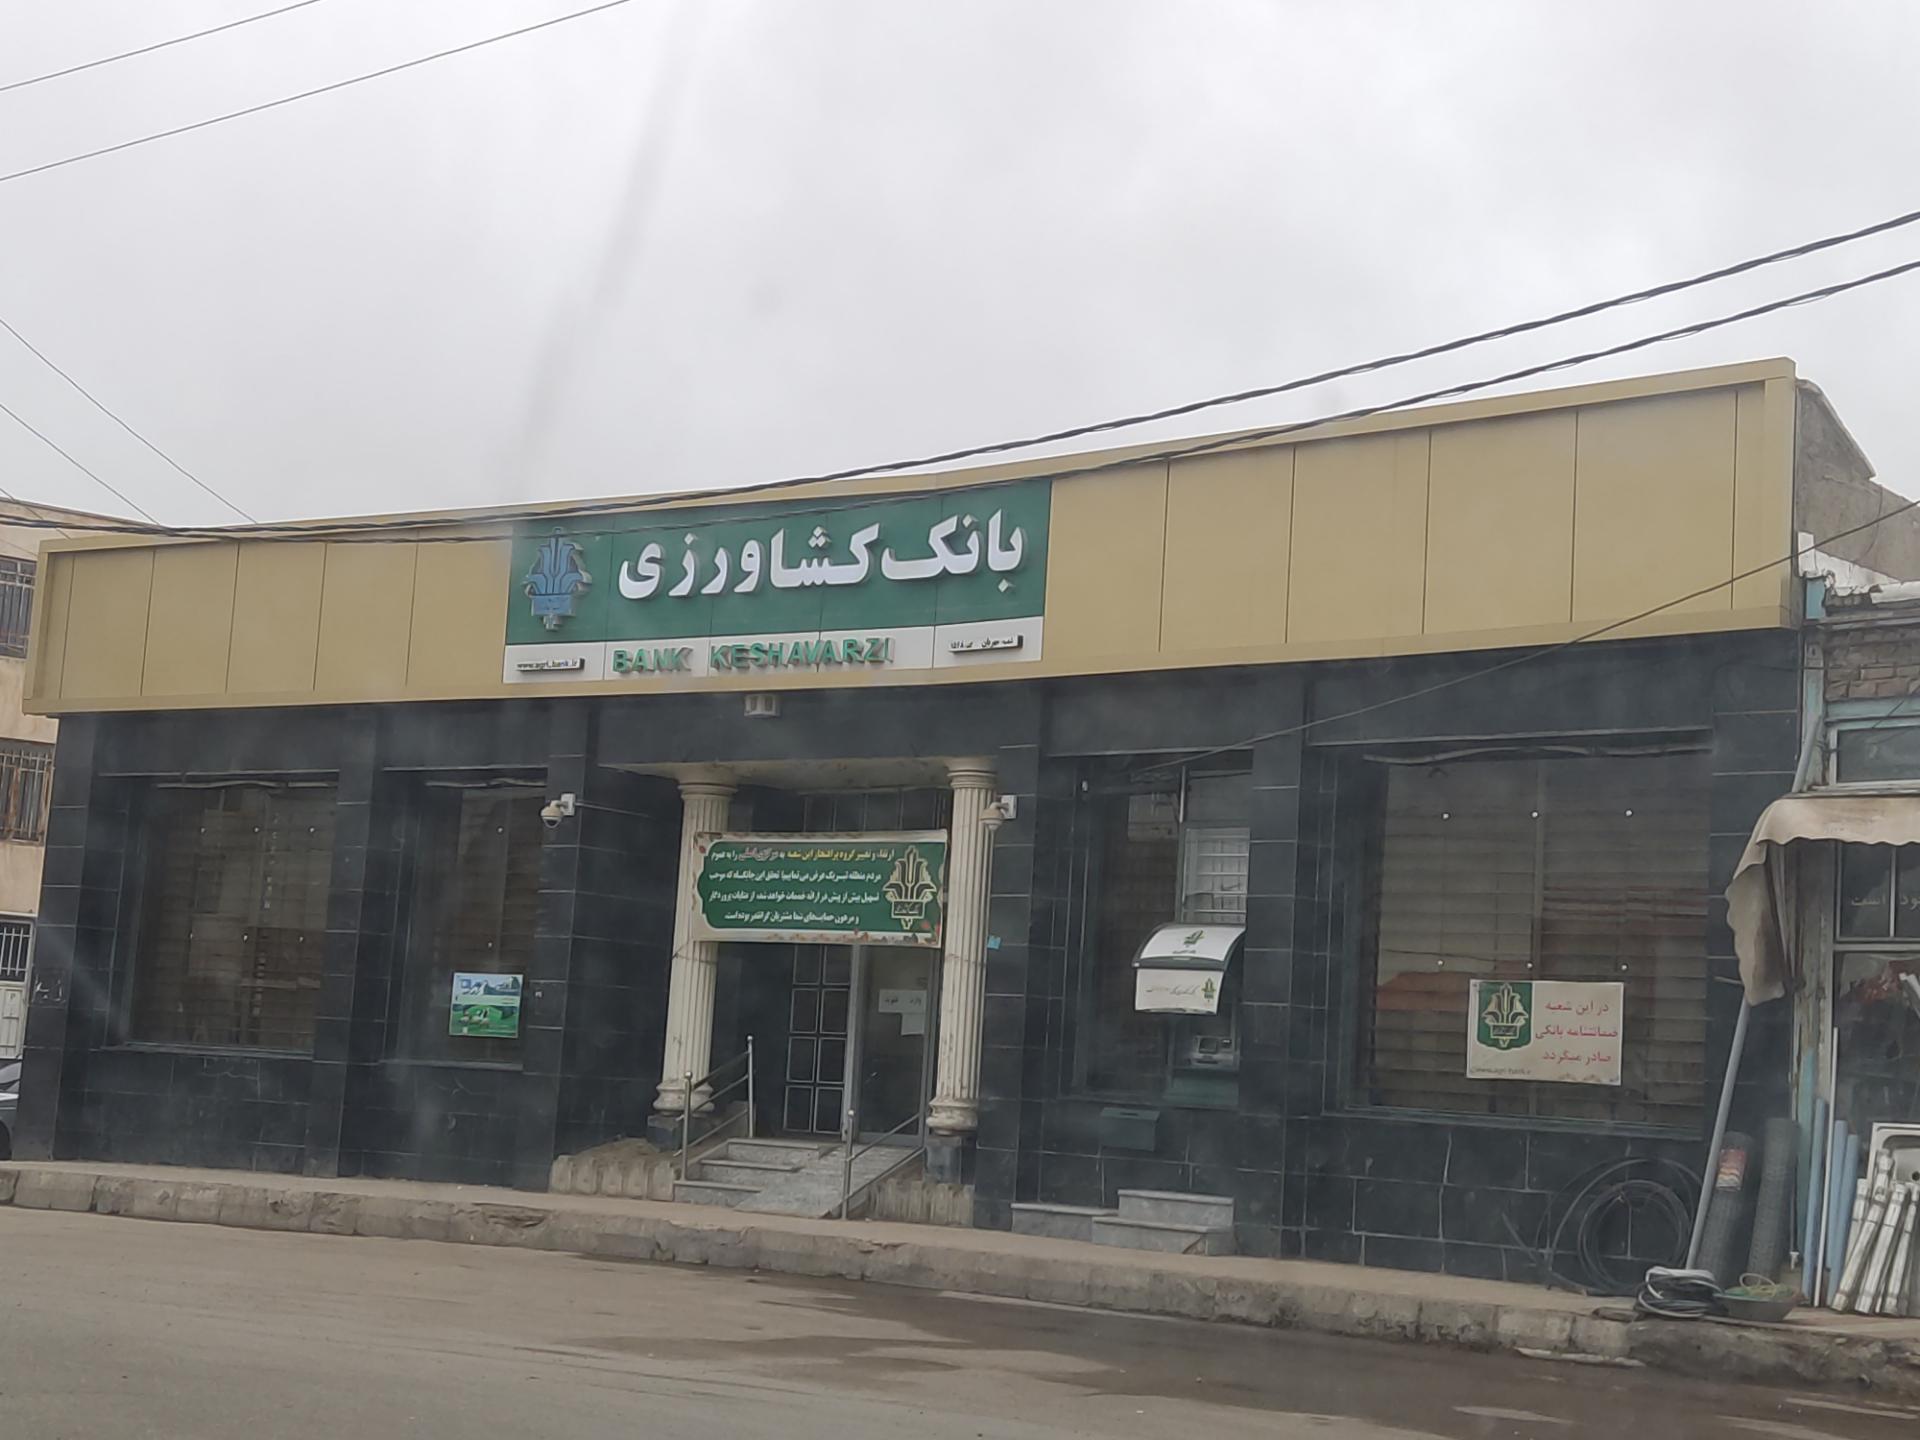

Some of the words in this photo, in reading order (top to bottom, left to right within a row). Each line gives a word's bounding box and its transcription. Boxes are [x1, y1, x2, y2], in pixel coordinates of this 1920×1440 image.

[881, 509, 1024, 595] بانک
[618, 523, 880, 600] کشاورزی
[612, 647, 691, 672] BANK
[710, 637, 893, 670] KESHAVARZI
[1851, 893, 1886, 906] است
[1545, 1000, 1572, 1014] شعبه
[1576, 1000, 1594, 1015] این
[1597, 1003, 1609, 1016] در
[1535, 1024, 1563, 1040] بانکی
[1585, 1050, 1611, 1065] صادر
